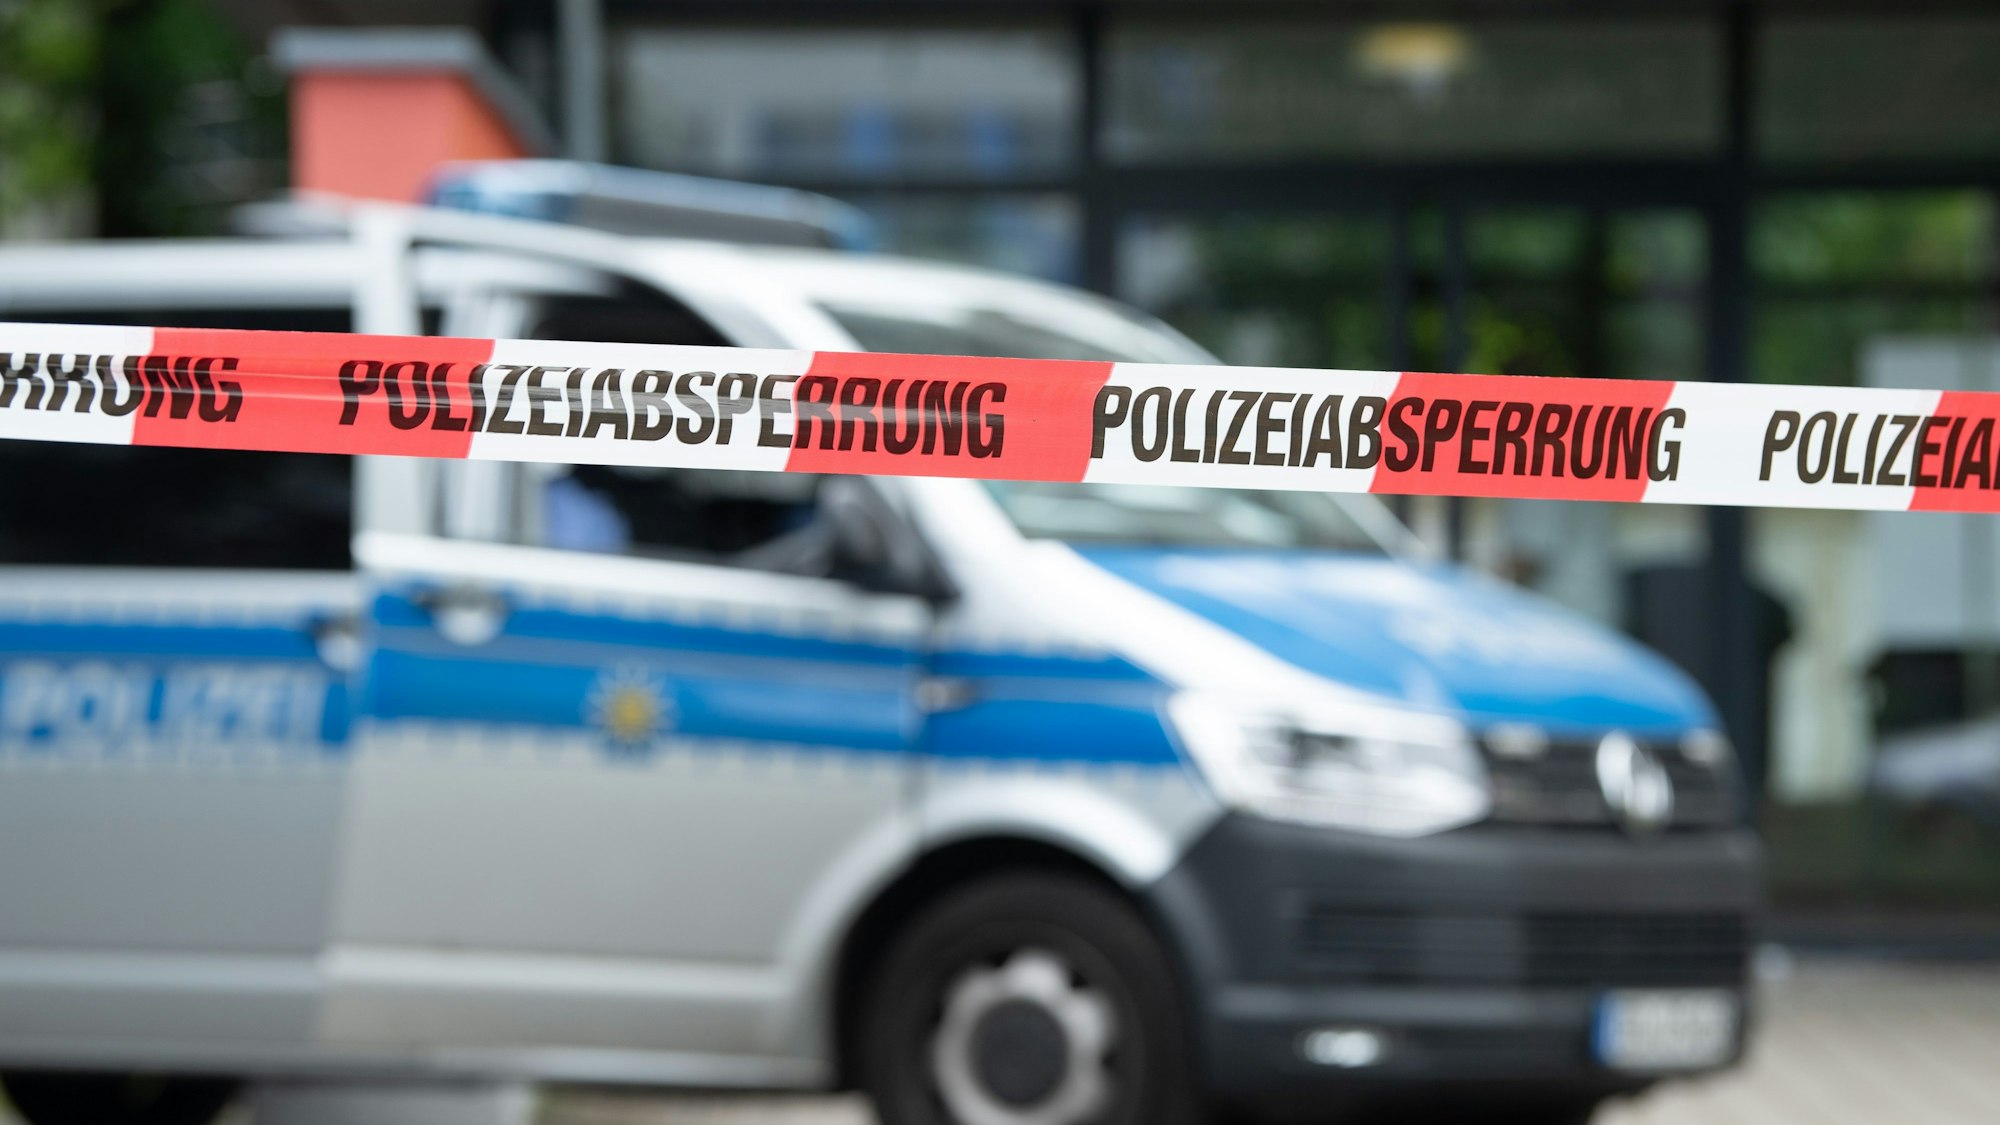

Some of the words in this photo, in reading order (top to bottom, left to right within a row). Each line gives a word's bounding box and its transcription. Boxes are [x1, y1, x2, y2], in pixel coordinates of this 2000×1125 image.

[0, 353, 243, 422] RRUNG
[338, 360, 1007, 458] POLIZEIABSPERRUNG
[1090, 385, 1686, 481] POLIZEIABSPERRUNG
[1759, 410, 2000, 490] POLIZEIA
